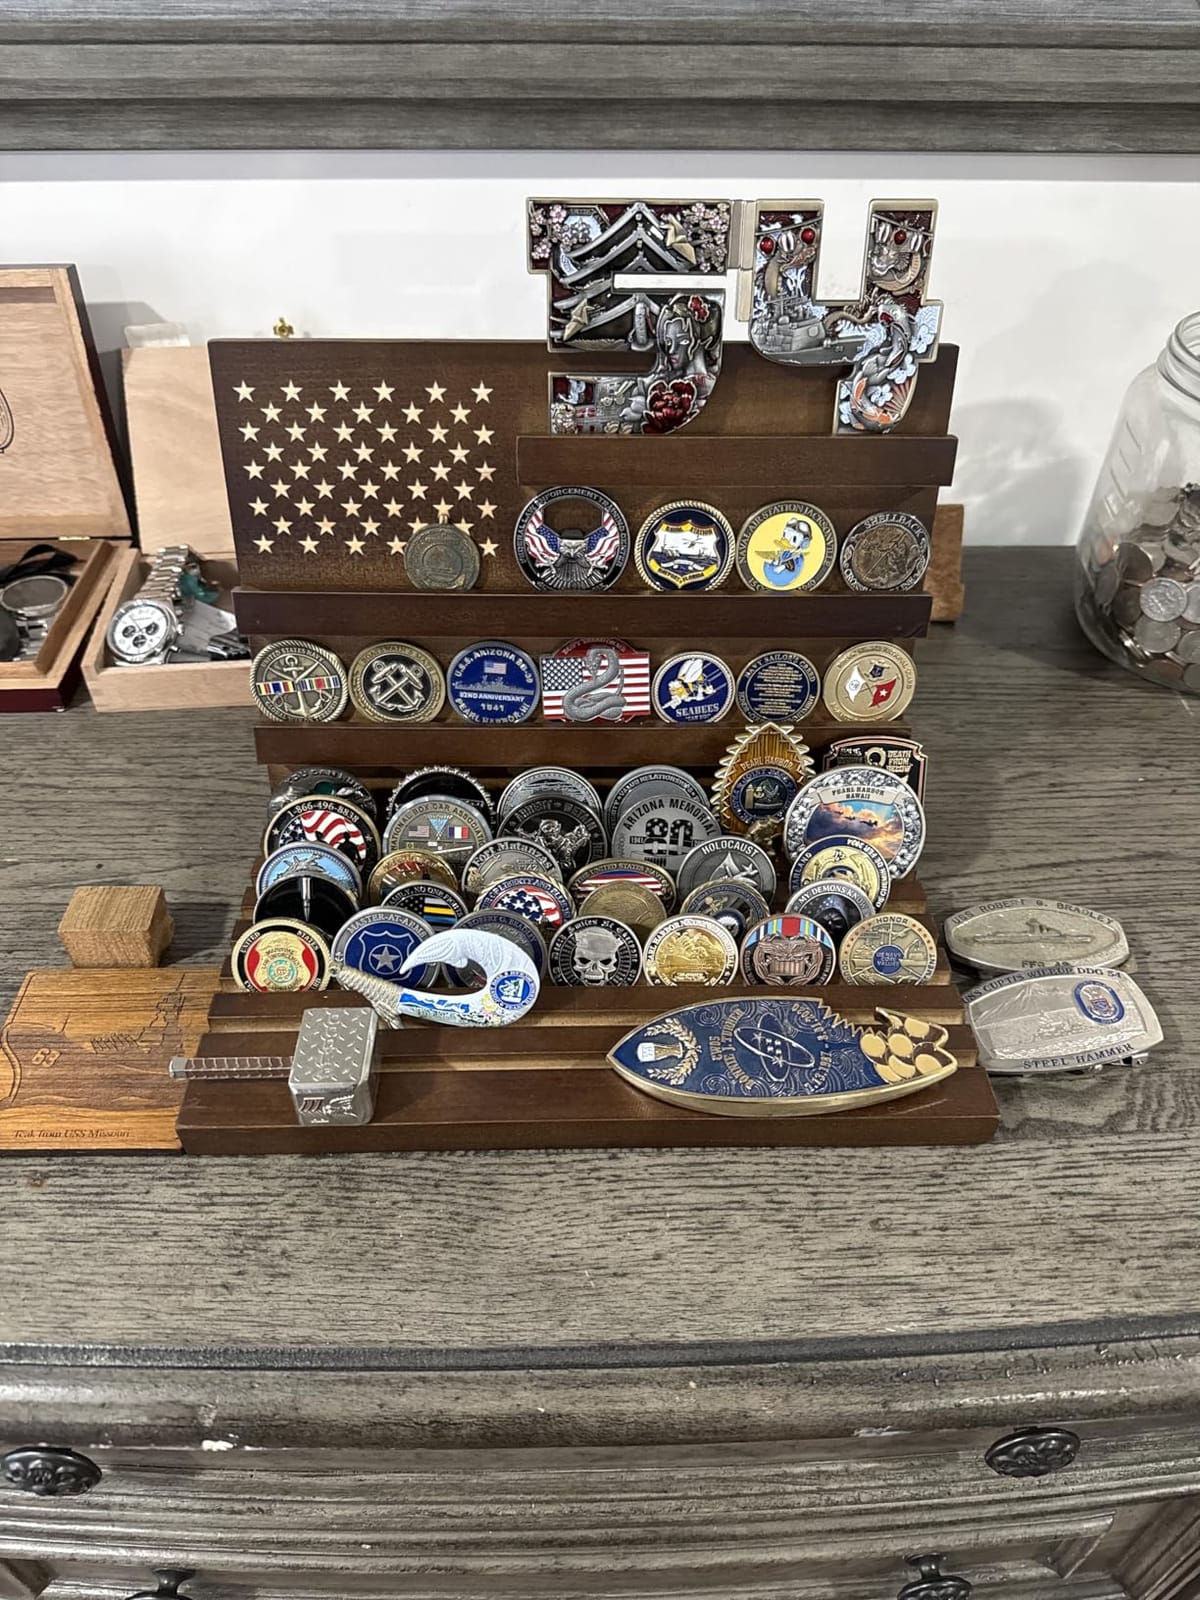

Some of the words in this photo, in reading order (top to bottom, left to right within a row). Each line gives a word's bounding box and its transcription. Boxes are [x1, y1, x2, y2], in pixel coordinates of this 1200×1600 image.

[536, 488, 599, 507] ENFORCEMENT
[615, 531, 628, 567] CENTER
[738, 531, 749, 564] NAVAL
[746, 517, 763, 533] AIR
[762, 504, 804, 519] STATION
[803, 506, 835, 567] JACKSONVILLE
[863, 513, 925, 538] SHELLBACK
[261, 650, 281, 668] UNITED
[473, 648, 516, 662] ARIZONA
[744, 659, 764, 679] NAVY
[799, 660, 817, 683] CREED
[478, 694, 525, 702] ANNIVERSARY
[480, 702, 505, 712] 1941
[454, 697, 481, 723] PEARL
[675, 702, 720, 718] SEABEES
[740, 756, 764, 771] PEARL
[764, 756, 794, 771] HARBOR
[888, 758, 910, 766] FROM
[831, 786, 856, 796] PEARL
[856, 786, 885, 796] HARBOR
[390, 813, 412, 851] NATIONAL
[413, 803, 430, 816] BOX
[432, 802, 451, 812] CAR
[452, 806, 487, 847] ASSOCIATIO
[623, 799, 666, 831] ARIZONA
[669, 798, 718, 836] MEMORIAL
[497, 841, 553, 870] Matanzas
[700, 839, 759, 858] HOLOCAUST
[618, 862, 644, 872] STATES
[798, 890, 811, 904] MY
[811, 884, 847, 895] DEMONS
[875, 916, 909, 924] HONOR
[951, 911, 975, 925] USS
[979, 899, 1026, 913] ROBERT
[1056, 902, 1114, 926] BRADLEY
[347, 912, 428, 939] MASTER-AT-ARMS
[509, 918, 537, 942] BRADLEY
[240, 931, 261, 953] UNITED
[296, 930, 320, 952] STATES
[962, 990, 982, 1004] USS
[983, 972, 1025, 993] CURTIS
[1027, 966, 1074, 979] WILBUR
[1076, 966, 1106, 977] DDG
[1107, 970, 1123, 980] 54
[720, 1008, 746, 1044] TURNER
[31, 1047, 62, 1068] 63
[1023, 1056, 1069, 1070] STEEL
[1074, 1042, 1135, 1065] HAMMER
[14, 1129, 35, 1138] Teak
[38, 1129, 62, 1138] from
[64, 1129, 88, 1138] USS
[89, 1129, 130, 1138] Missouri
